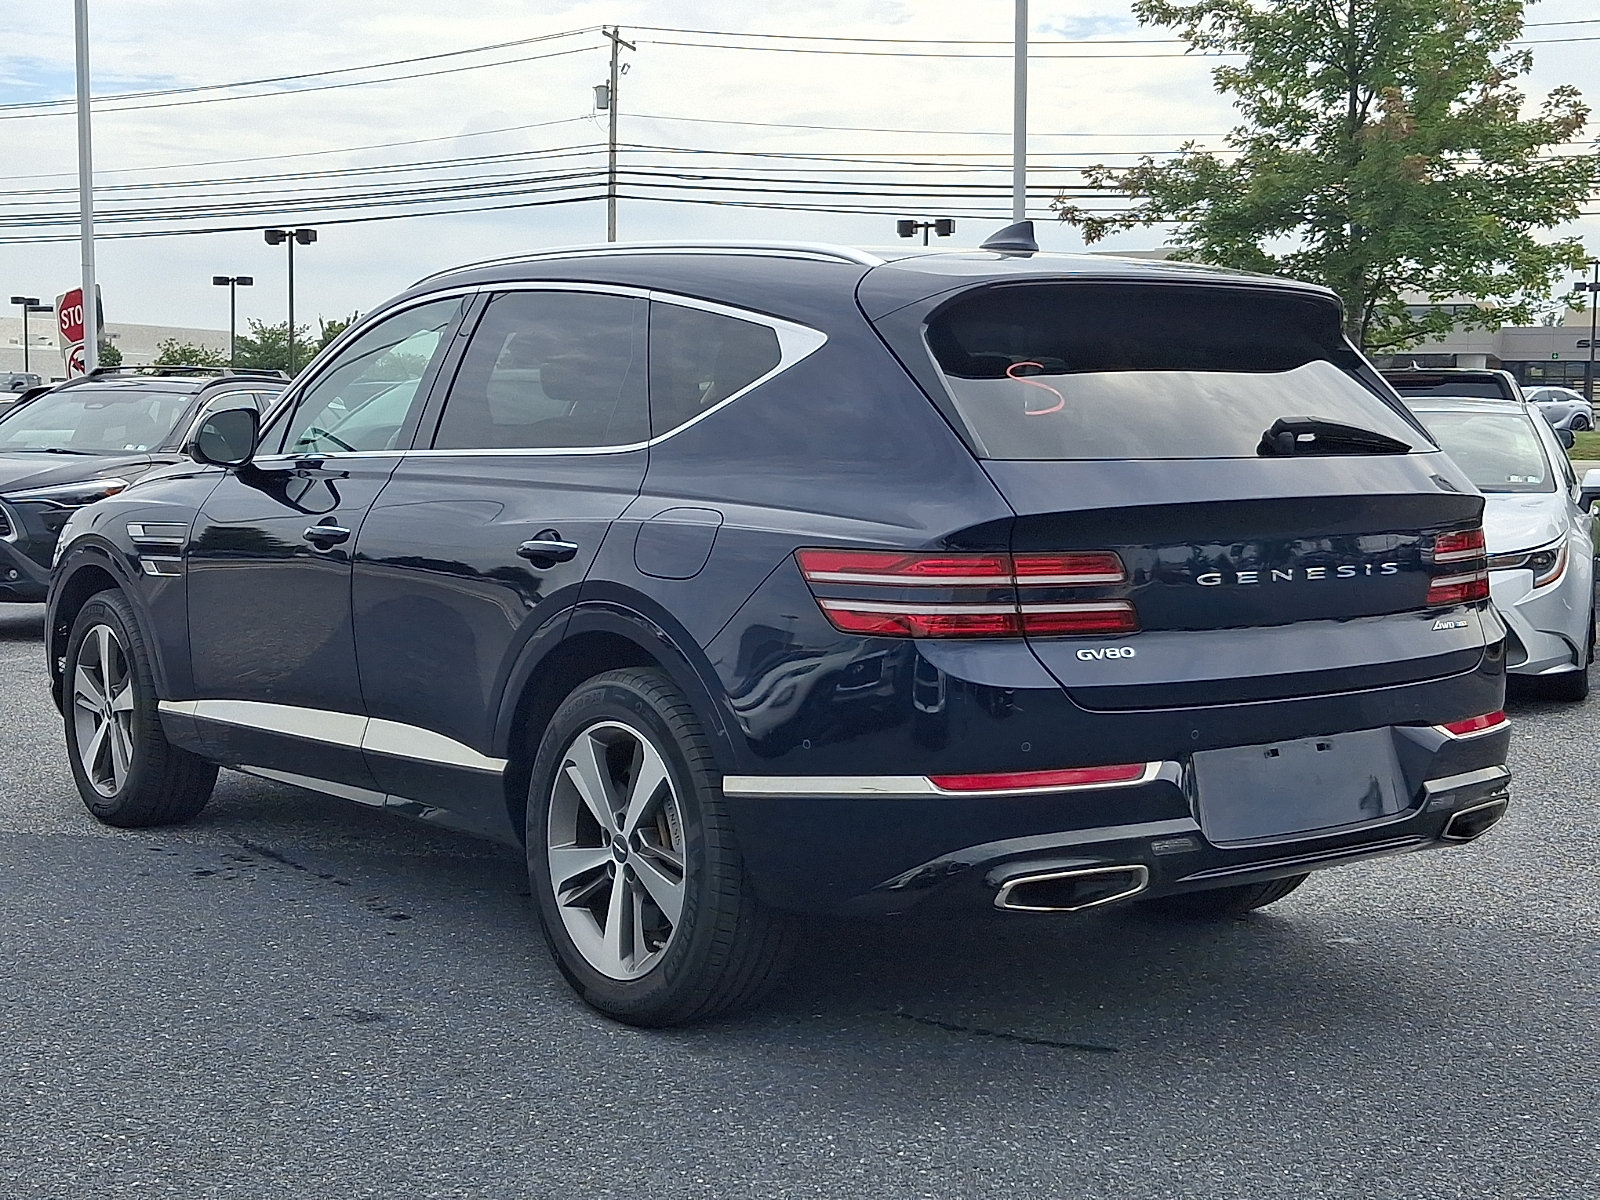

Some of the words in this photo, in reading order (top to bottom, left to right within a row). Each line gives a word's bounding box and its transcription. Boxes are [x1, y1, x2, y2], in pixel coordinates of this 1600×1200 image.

[61, 305, 83, 329] STO
[1006, 361, 1065, 416] S
[1196, 562, 1399, 586] GENESIS
[1076, 646, 1135, 661] GV80
